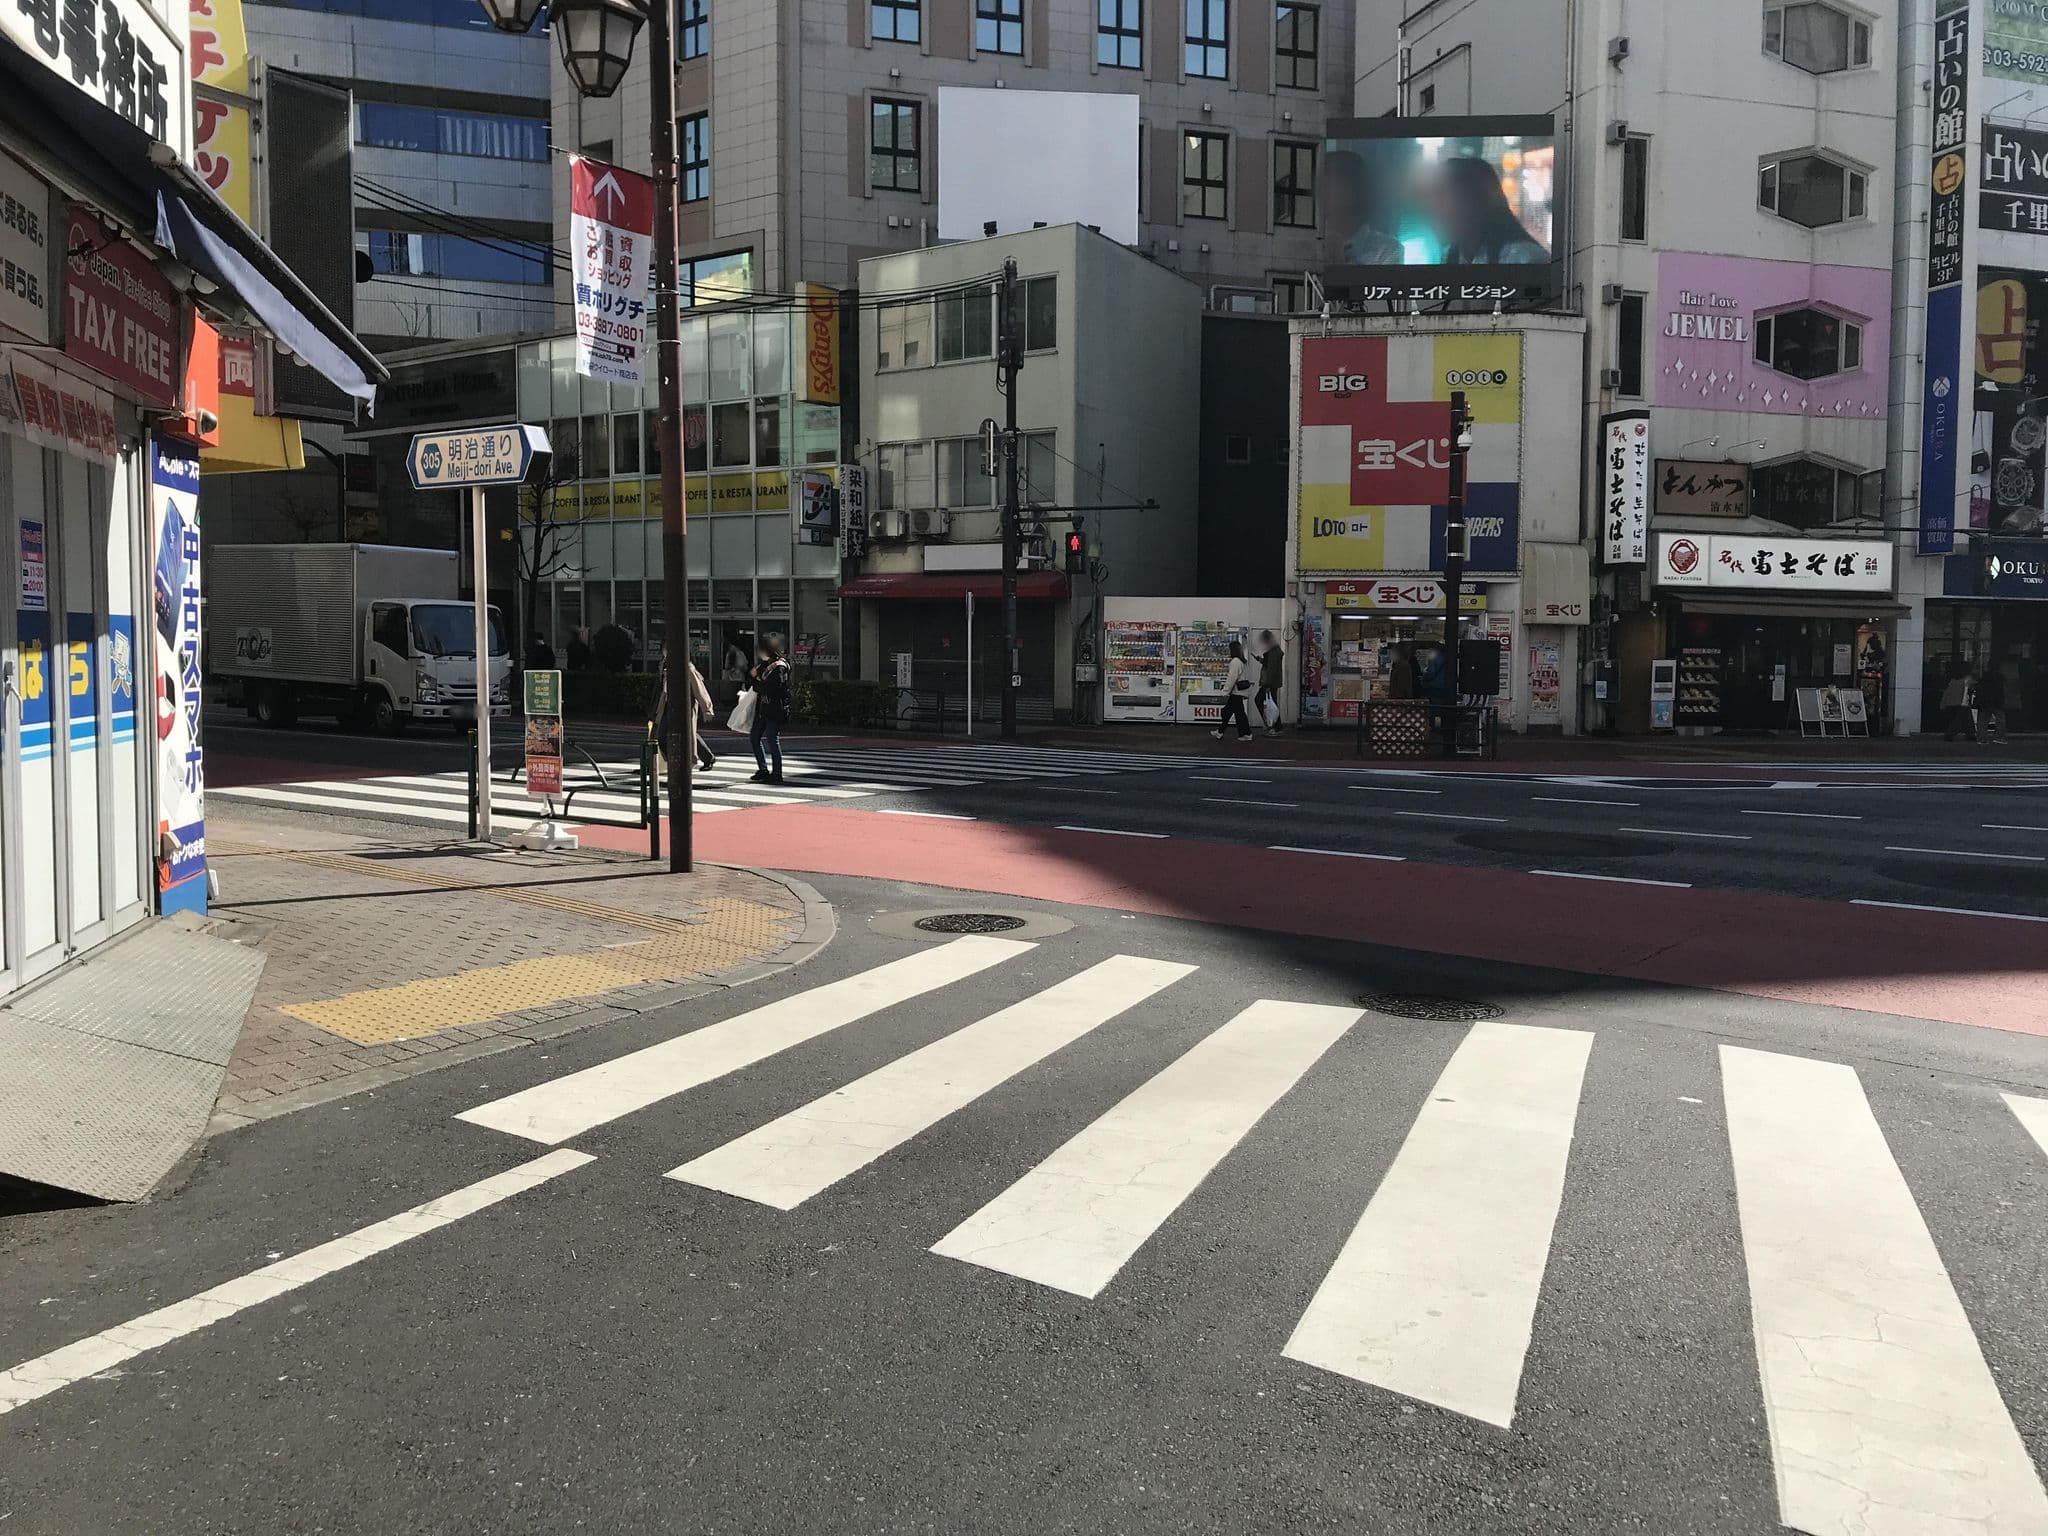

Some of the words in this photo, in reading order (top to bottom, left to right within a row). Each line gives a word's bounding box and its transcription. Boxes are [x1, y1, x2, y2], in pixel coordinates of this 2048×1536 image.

[1993, 49, 2048, 72] 03-592
[1936, 18, 1966, 148] 占いの館
[1985, 133, 2048, 183] 占い
[588, 262, 632, 289] ショッピング
[1937, 267, 1955, 283] 3F
[576, 282, 645, 319] 質ホリグチ
[1364, 285, 1450, 299] リア・エイド
[1461, 285, 1516, 299] ビジョン
[1680, 291, 1705, 306] Hair
[1710, 293, 1738, 308] Love
[69, 283, 116, 357] TAX
[123, 316, 170, 385] FREE
[578, 311, 644, 342] 03-3987-0801
[1664, 312, 1750, 342] JEWEL
[810, 297, 837, 394] Denny's
[1319, 368, 1368, 393] BIG
[1446, 369, 1507, 386] toto
[448, 434, 512, 461] 明治通り
[1358, 437, 1450, 470] 宝くじ
[423, 451, 441, 470] 305
[447, 460, 492, 480] Meiji-dori
[494, 460, 515, 475] Ave.
[1609, 447, 1627, 541] 富士そば
[1313, 517, 1345, 538] LOTO
[1444, 517, 1504, 538] BERS
[1718, 550, 1745, 574] 名代
[1751, 550, 1859, 577] 富士そば
[1865, 557, 1878, 565] 24
[2003, 561, 2048, 575] OKU
[1339, 583, 1356, 592] BIG
[1378, 585, 1435, 604] 宝くじ
[1546, 603, 1582, 617] 宝くじ
[181, 525, 201, 794] 中古スマホ
[1194, 706, 1223, 718] KIRI
